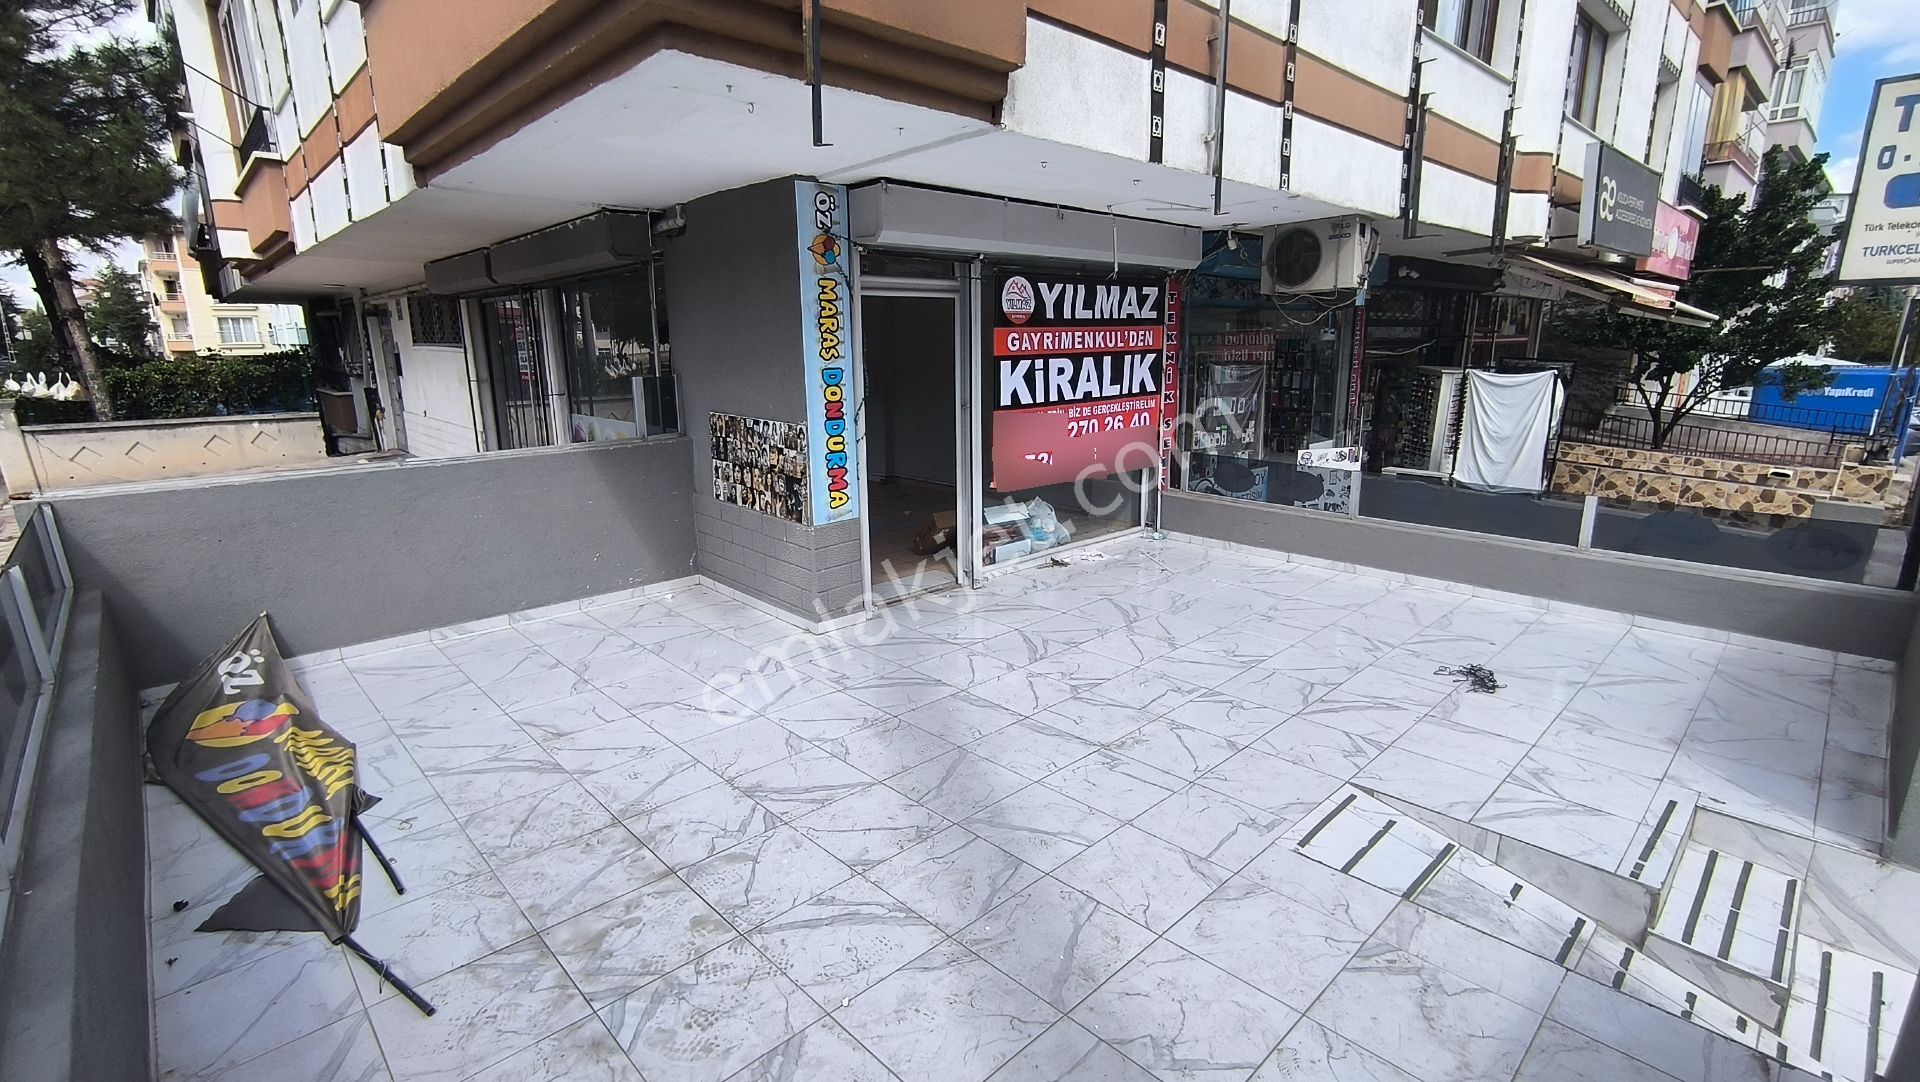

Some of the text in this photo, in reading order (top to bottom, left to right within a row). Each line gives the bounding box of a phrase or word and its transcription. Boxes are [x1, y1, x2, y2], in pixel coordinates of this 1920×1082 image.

[814, 191, 836, 230] ÖZ
[1864, 223, 1885, 232] Türk
[1006, 298, 1031, 310] YILMAZ
[1037, 282, 1159, 319] YILMAZ
[1068, 398, 1156, 418] BİZ DE GERÇEKLEŞTİRELİM
[821, 367, 852, 509] DONDURMA
[1067, 412, 1150, 438] 270 26 40
